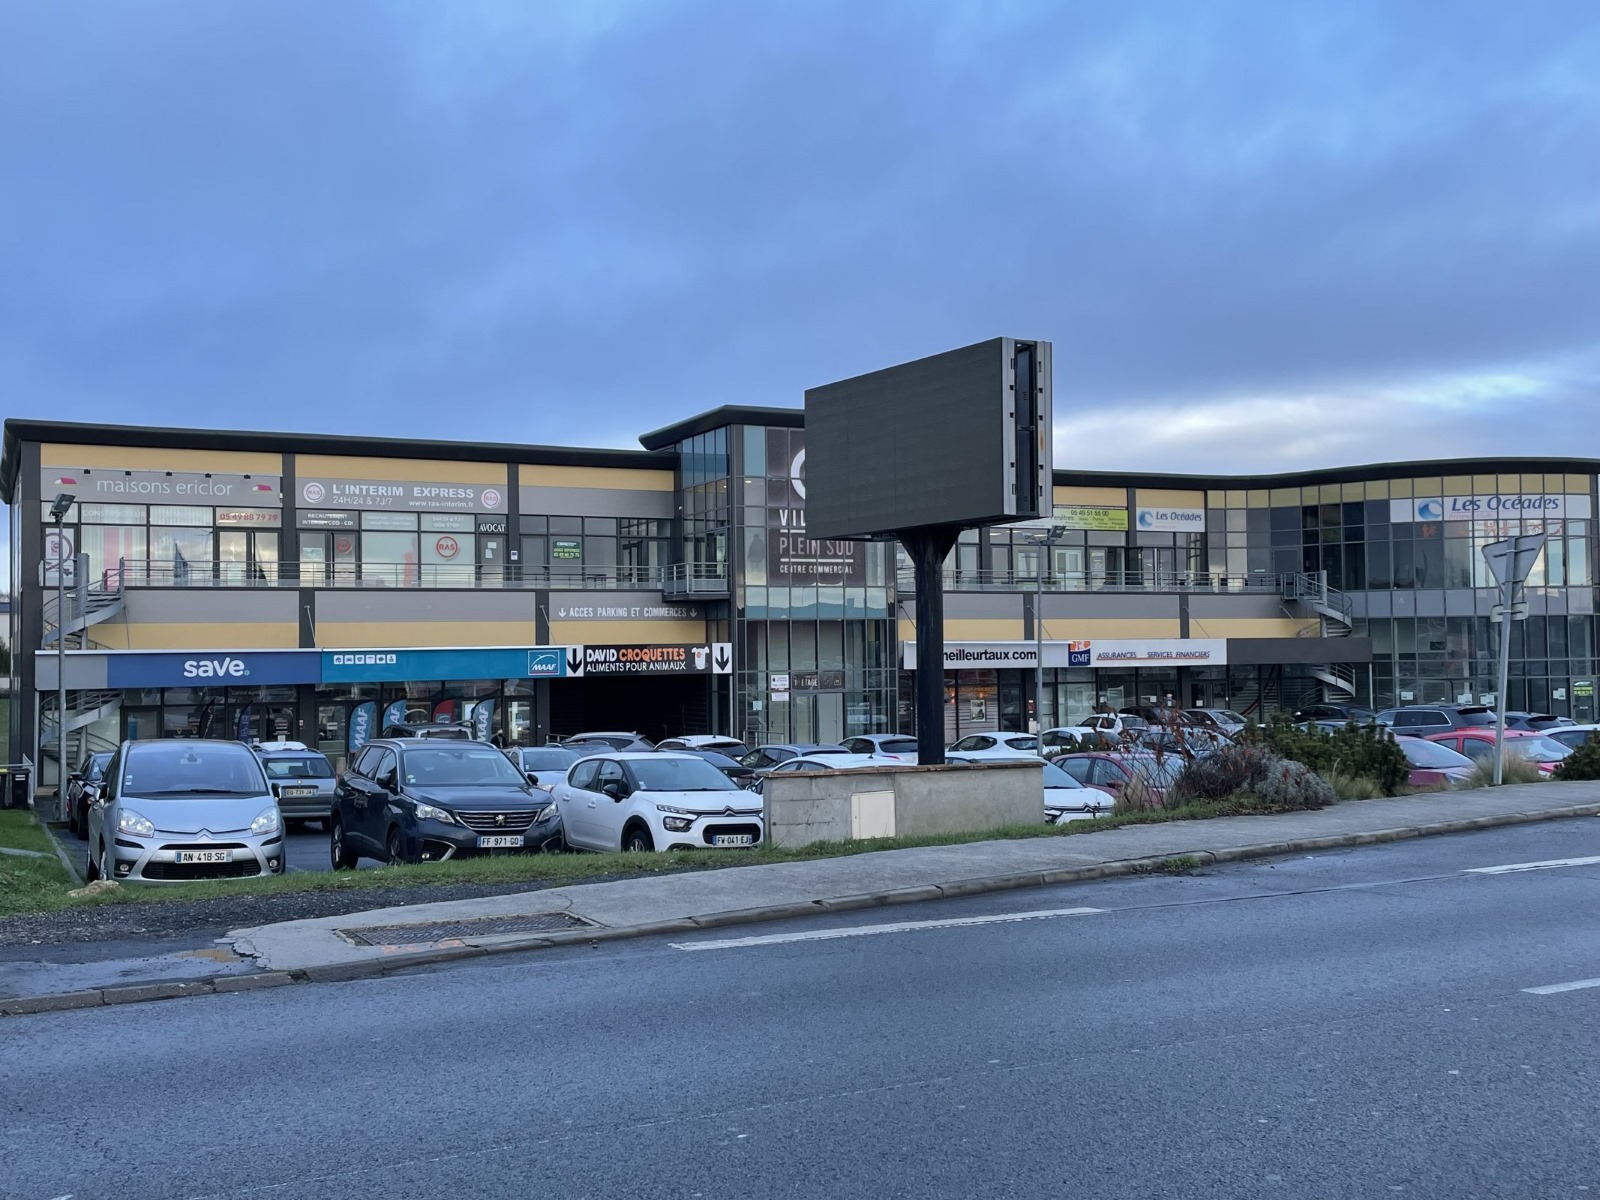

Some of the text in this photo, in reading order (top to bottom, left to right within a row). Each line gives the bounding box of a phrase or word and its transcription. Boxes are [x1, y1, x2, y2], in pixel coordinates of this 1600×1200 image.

[96, 478, 233, 496] maisons ericlor
[332, 484, 474, 499] L'INTERIM EXPRESS
[333, 496, 393, 506] 24H/24 & 7J/7
[408, 500, 474, 508] www.ras-interim.fr
[1451, 495, 1560, 512] Les Océades
[219, 512, 230, 521] 05
[255, 513, 266, 521] 79
[780, 509, 805, 527] VIL
[1155, 511, 1202, 522] Les Océades
[478, 523, 506, 532] AVOCAT
[439, 543, 455, 551] RAS
[779, 537, 854, 556] PLEIN SUD
[808, 565, 853, 574] COMMERCAL
[569, 607, 687, 618] ACCES PARKING ET COMMERCES
[586, 648, 686, 662] DAVID CROQUETTES
[1071, 653, 1090, 663] GMF
[1097, 650, 1210, 659] ASSURANCES SERVICES FINANCIERS
[531, 663, 557, 671] MAAF
[586, 661, 687, 673] ALIMENTS POUR ANIMAUX
[389, 706, 400, 725] AF
[354, 707, 367, 748] MAAF
[477, 705, 489, 743] MAAF
[182, 852, 226, 862] AN-418-SG
